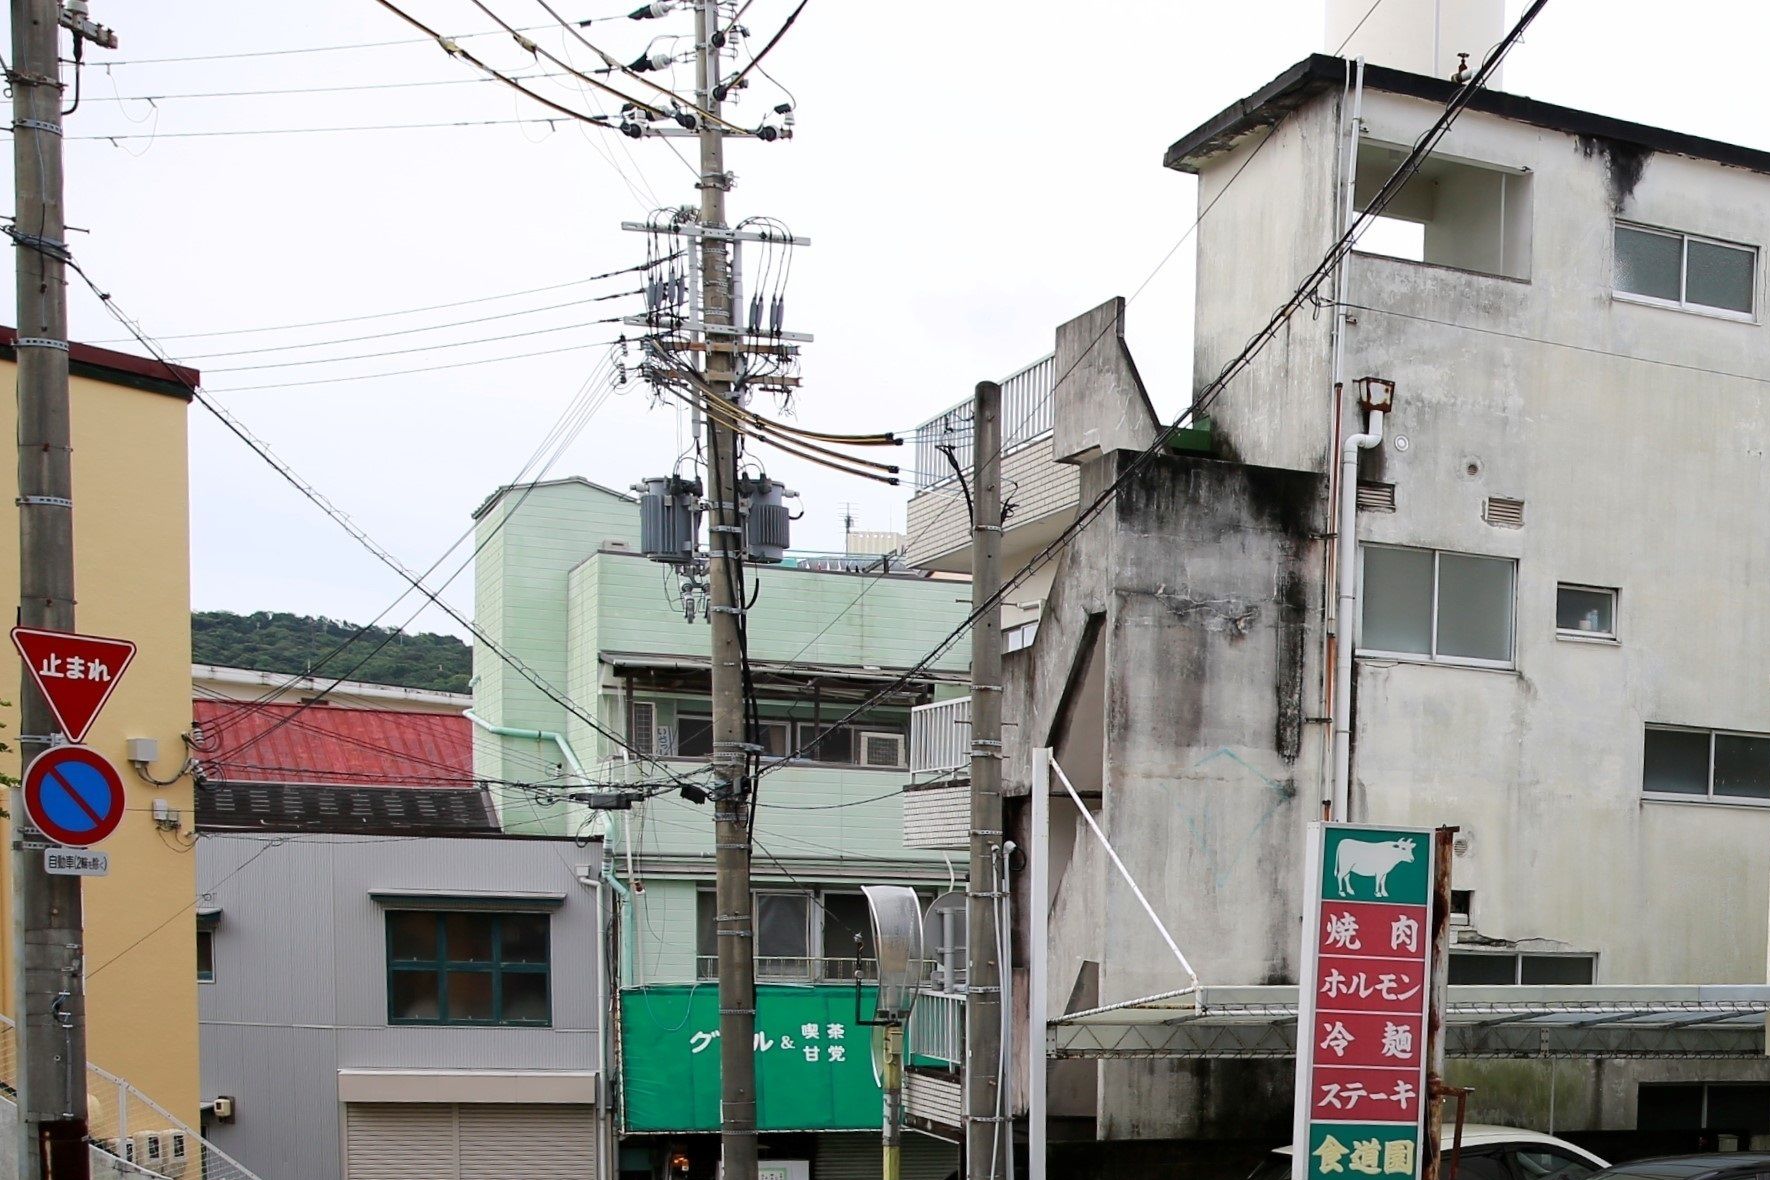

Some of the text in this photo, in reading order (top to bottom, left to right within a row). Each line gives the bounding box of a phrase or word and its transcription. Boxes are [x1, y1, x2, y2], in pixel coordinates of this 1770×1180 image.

[39, 652, 111, 682] 止まれ
[1324, 911, 1419, 953] 焼肉
[1319, 968, 1421, 1001] ホルモン
[689, 1029, 796, 1054] グル &
[801, 1022, 845, 1040] 喫茶
[1320, 1021, 1413, 1059] 冷麺
[802, 1045, 846, 1062] 甘党
[1317, 1079, 1416, 1110] ステーキ
[1312, 1134, 1415, 1175] 食道園
